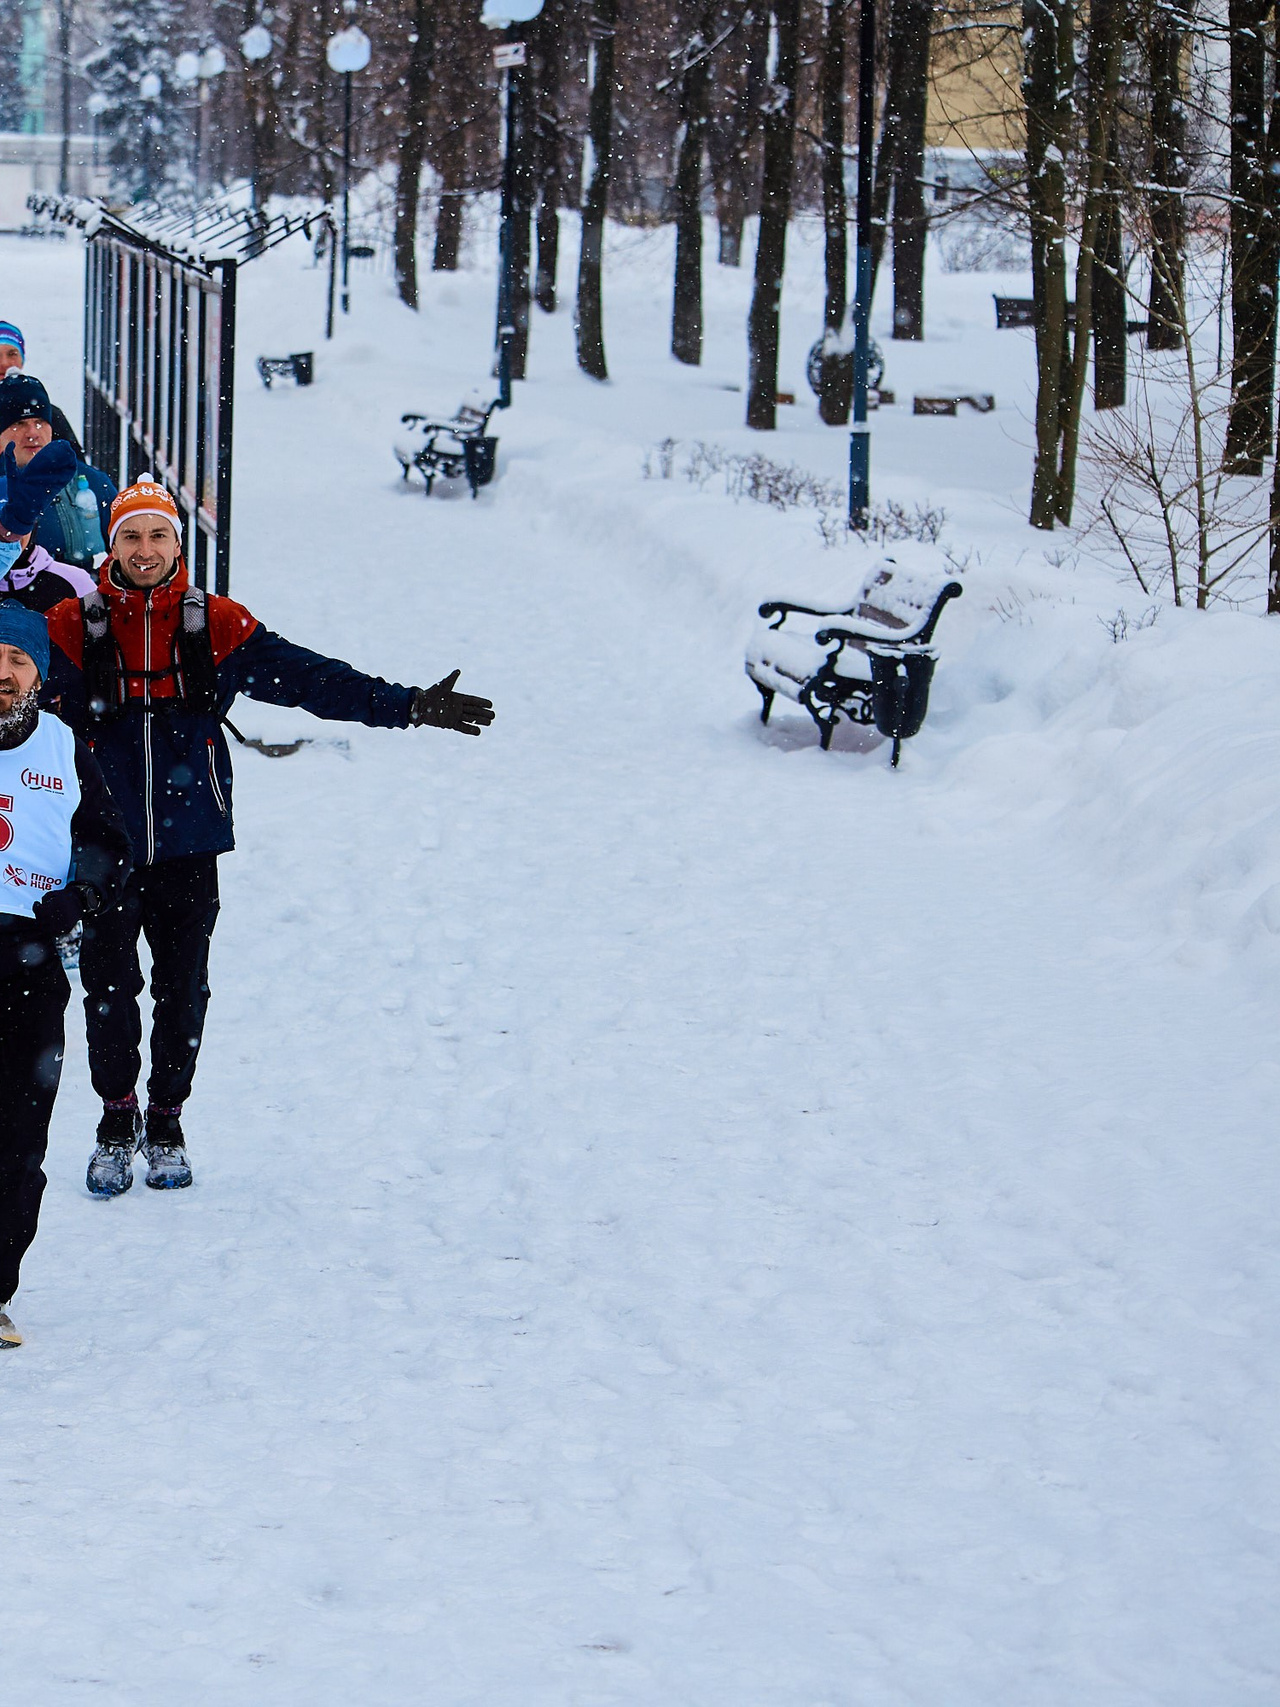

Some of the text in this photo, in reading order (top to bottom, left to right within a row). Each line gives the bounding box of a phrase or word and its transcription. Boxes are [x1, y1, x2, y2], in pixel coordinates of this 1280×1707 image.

[28, 772, 63, 790] НЦВ
[30, 880, 53, 891] НЦВ
[31, 872, 62, 886] ППОО
